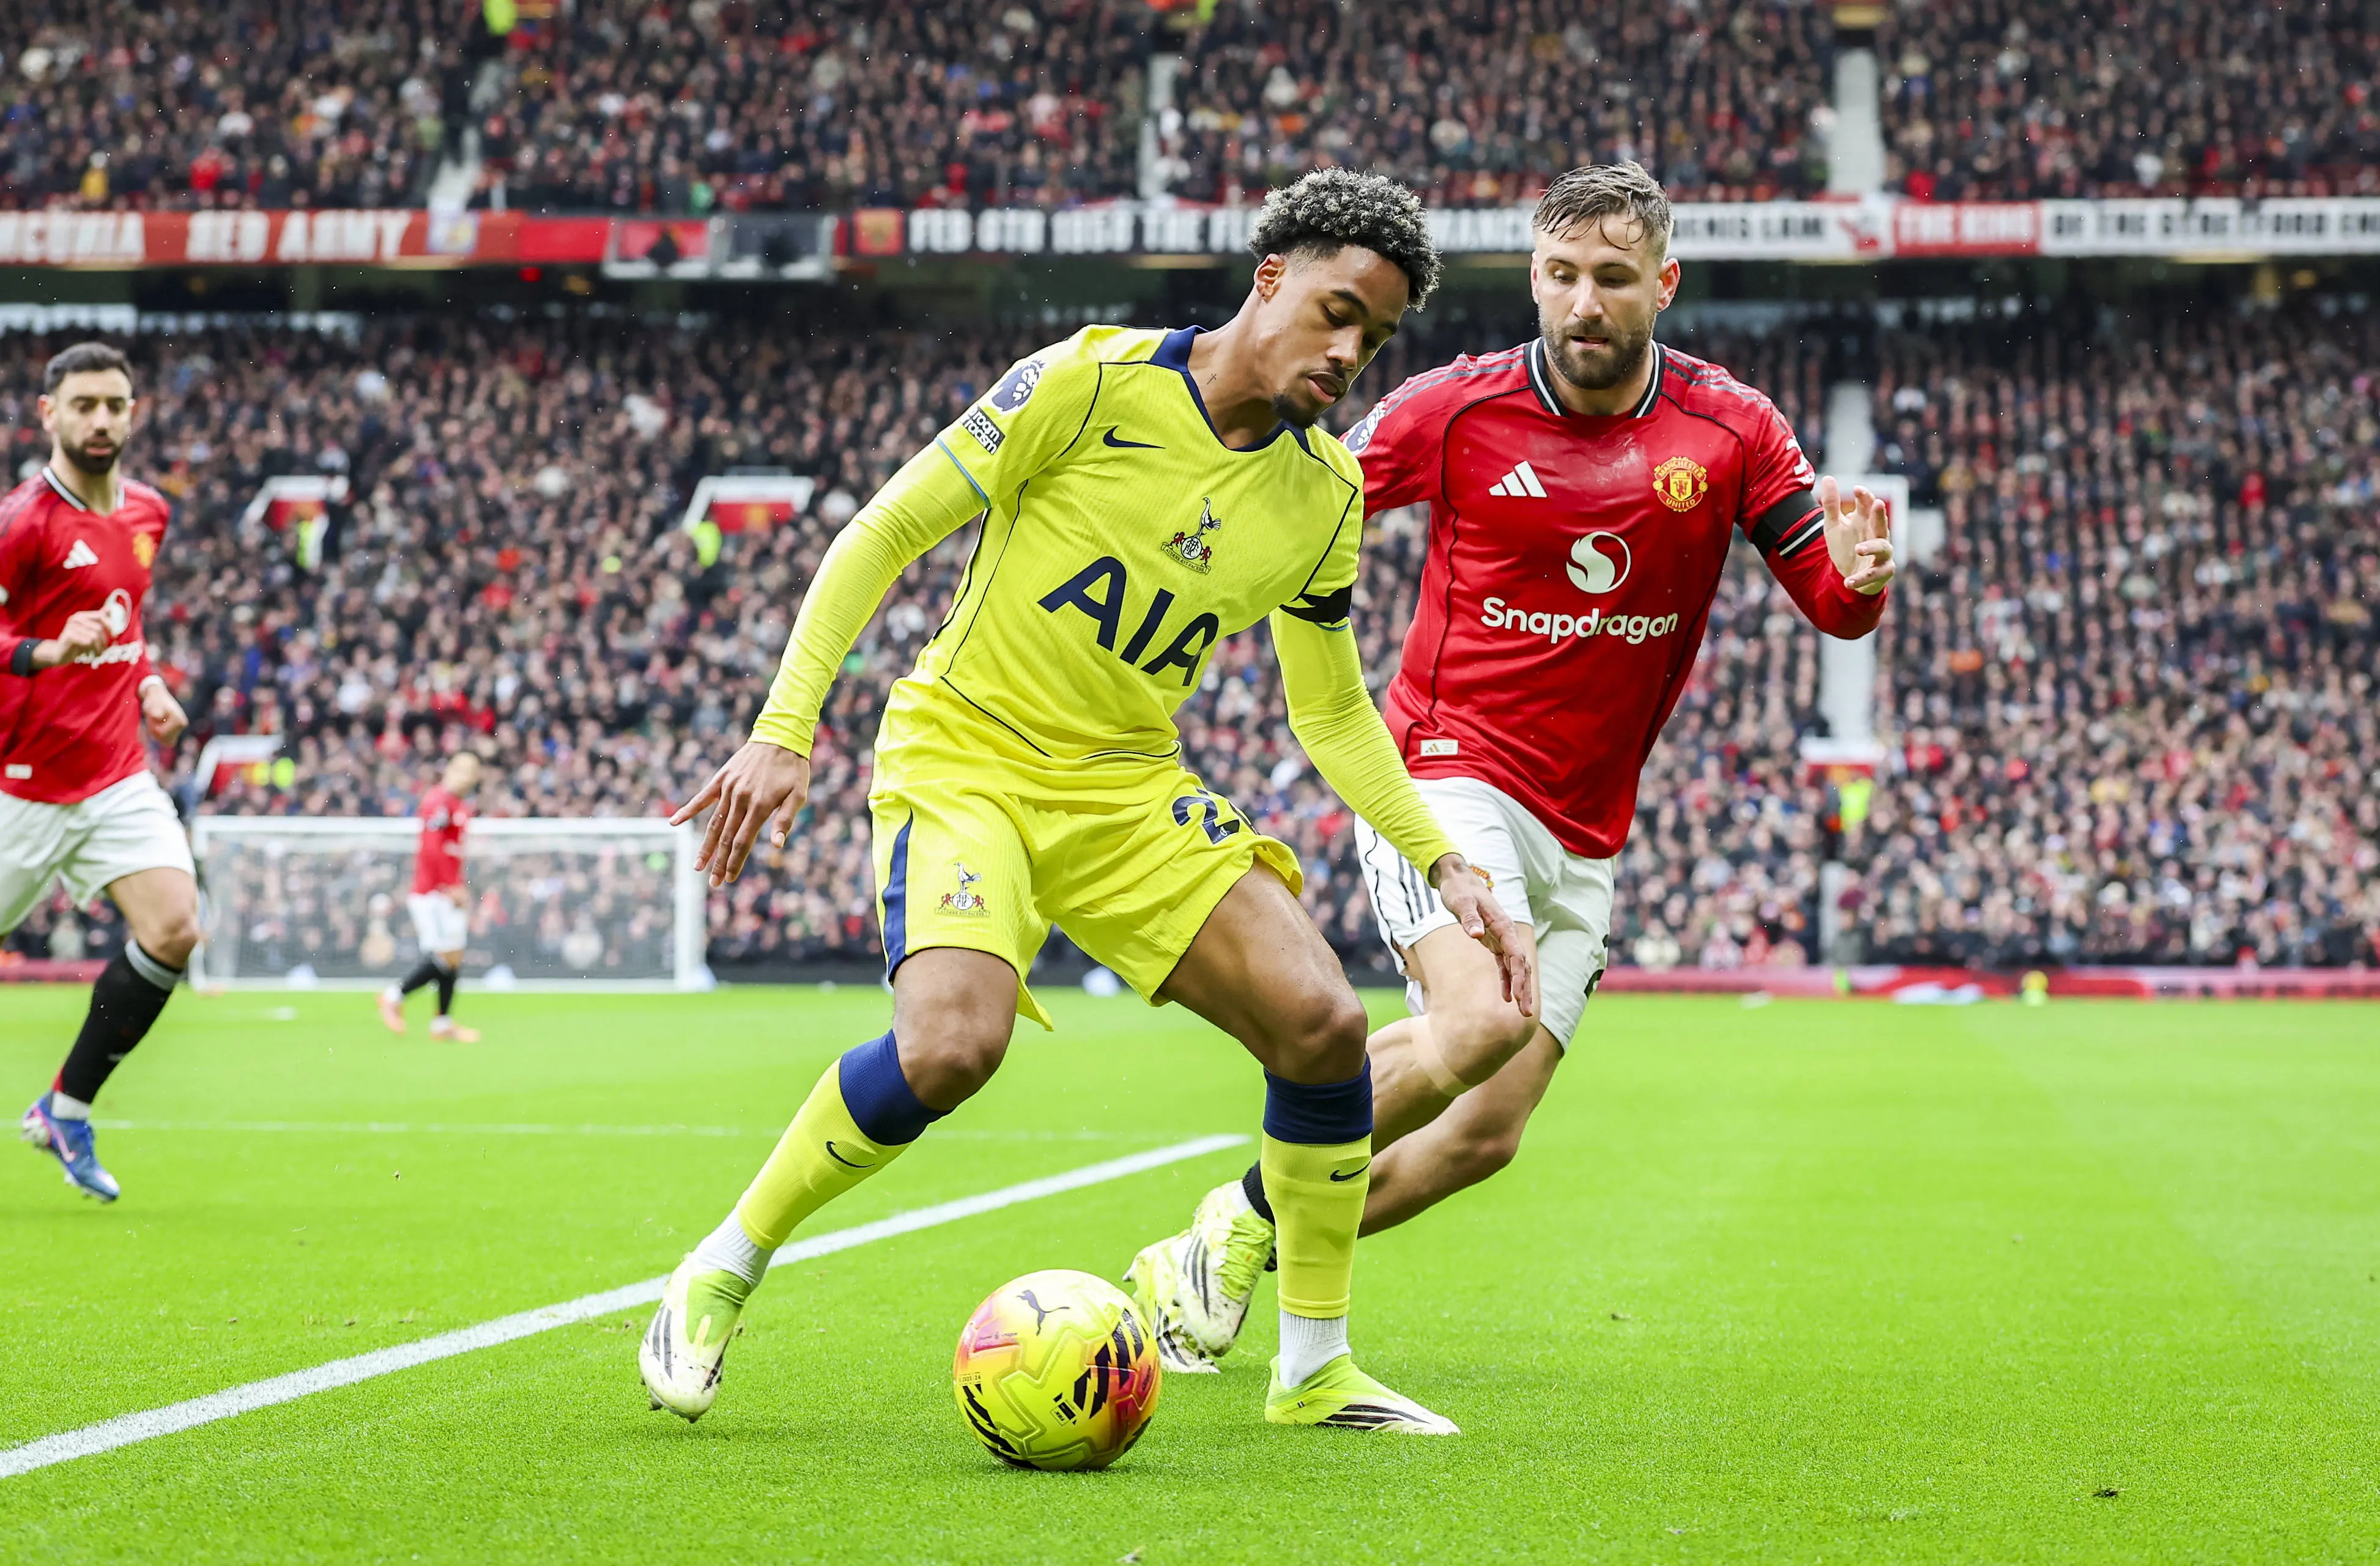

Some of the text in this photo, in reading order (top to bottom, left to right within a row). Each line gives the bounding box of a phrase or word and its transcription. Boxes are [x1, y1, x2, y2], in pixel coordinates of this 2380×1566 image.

[187, 210, 270, 264] RED
[276, 209, 413, 263] ARMY
[909, 209, 973, 254] FEB
[1142, 209, 1206, 254] THE
[963, 418, 998, 455] racism
[972, 410, 1000, 443] room
[1658, 460, 1703, 479] MANCHESTER
[1666, 497, 1696, 509] UNITED
[1037, 556, 1219, 686] AIA
[1481, 597, 1679, 644] Snapdragon
